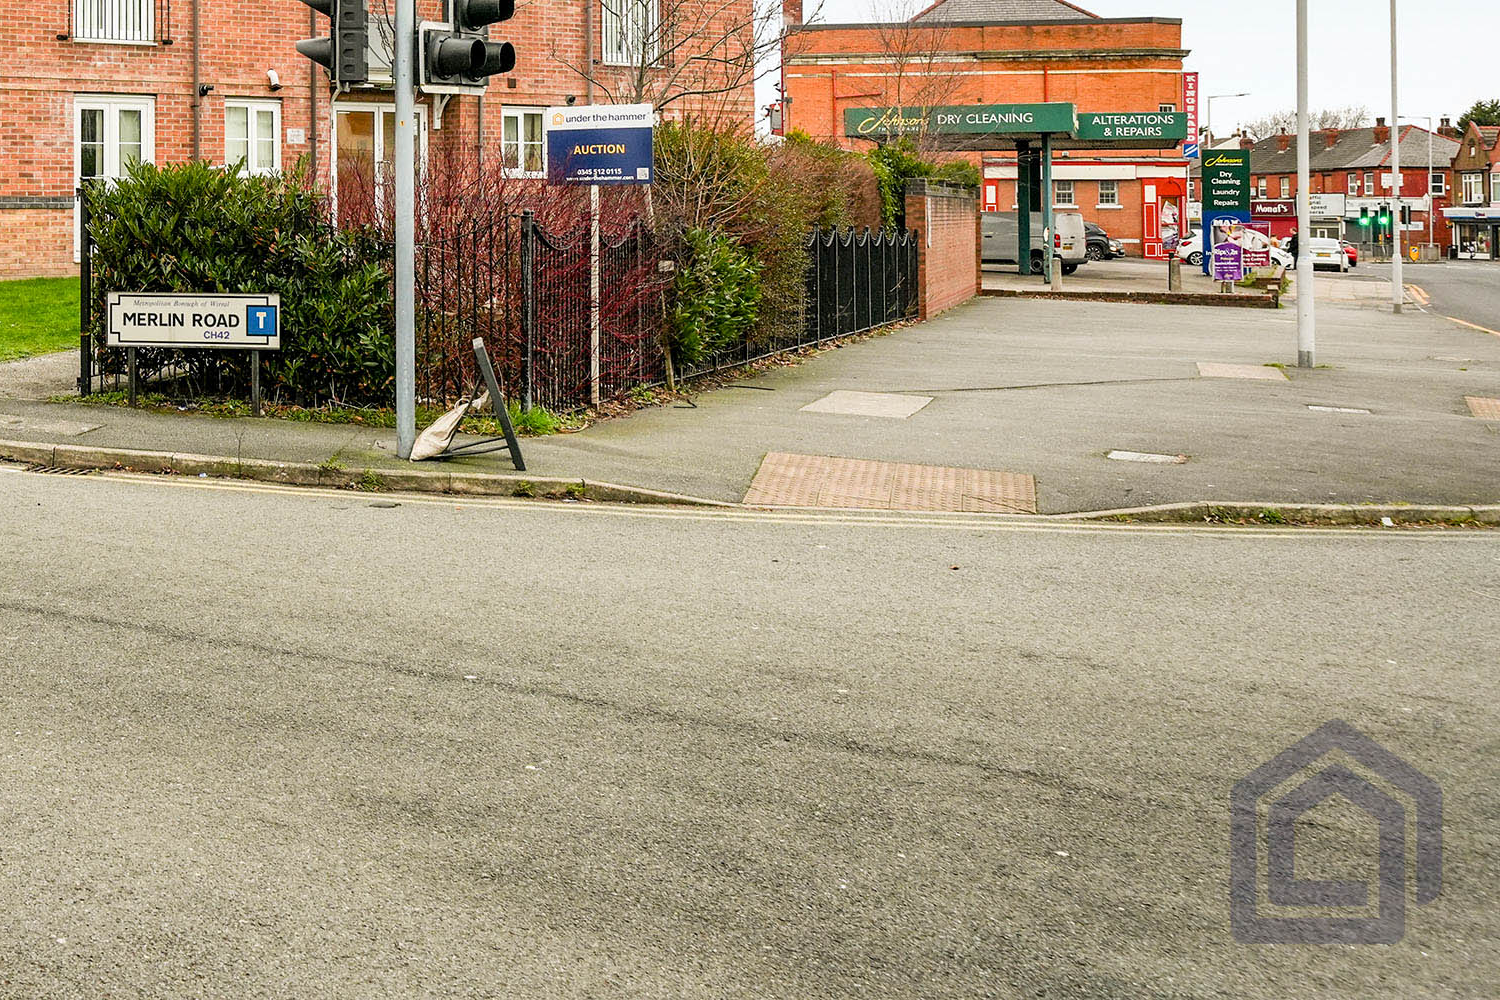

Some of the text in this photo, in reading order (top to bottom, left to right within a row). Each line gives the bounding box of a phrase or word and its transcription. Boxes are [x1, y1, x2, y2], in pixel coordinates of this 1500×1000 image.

[1185, 75, 1196, 142] KINGSLAND
[565, 113, 646, 123] under the hammer
[937, 112, 1033, 124] DRY CLEANING
[1092, 115, 1174, 125] ALTERATIONS
[1103, 126, 1162, 137] & REPAIRS
[573, 143, 626, 155] AUCTION
[606, 167, 622, 175] 0115
[1213, 199, 1239, 207] Repairs
[133, 299, 171, 307] Metropolitan
[122, 312, 240, 328] MERLIN ROAD
[203, 330, 230, 340] CH42
